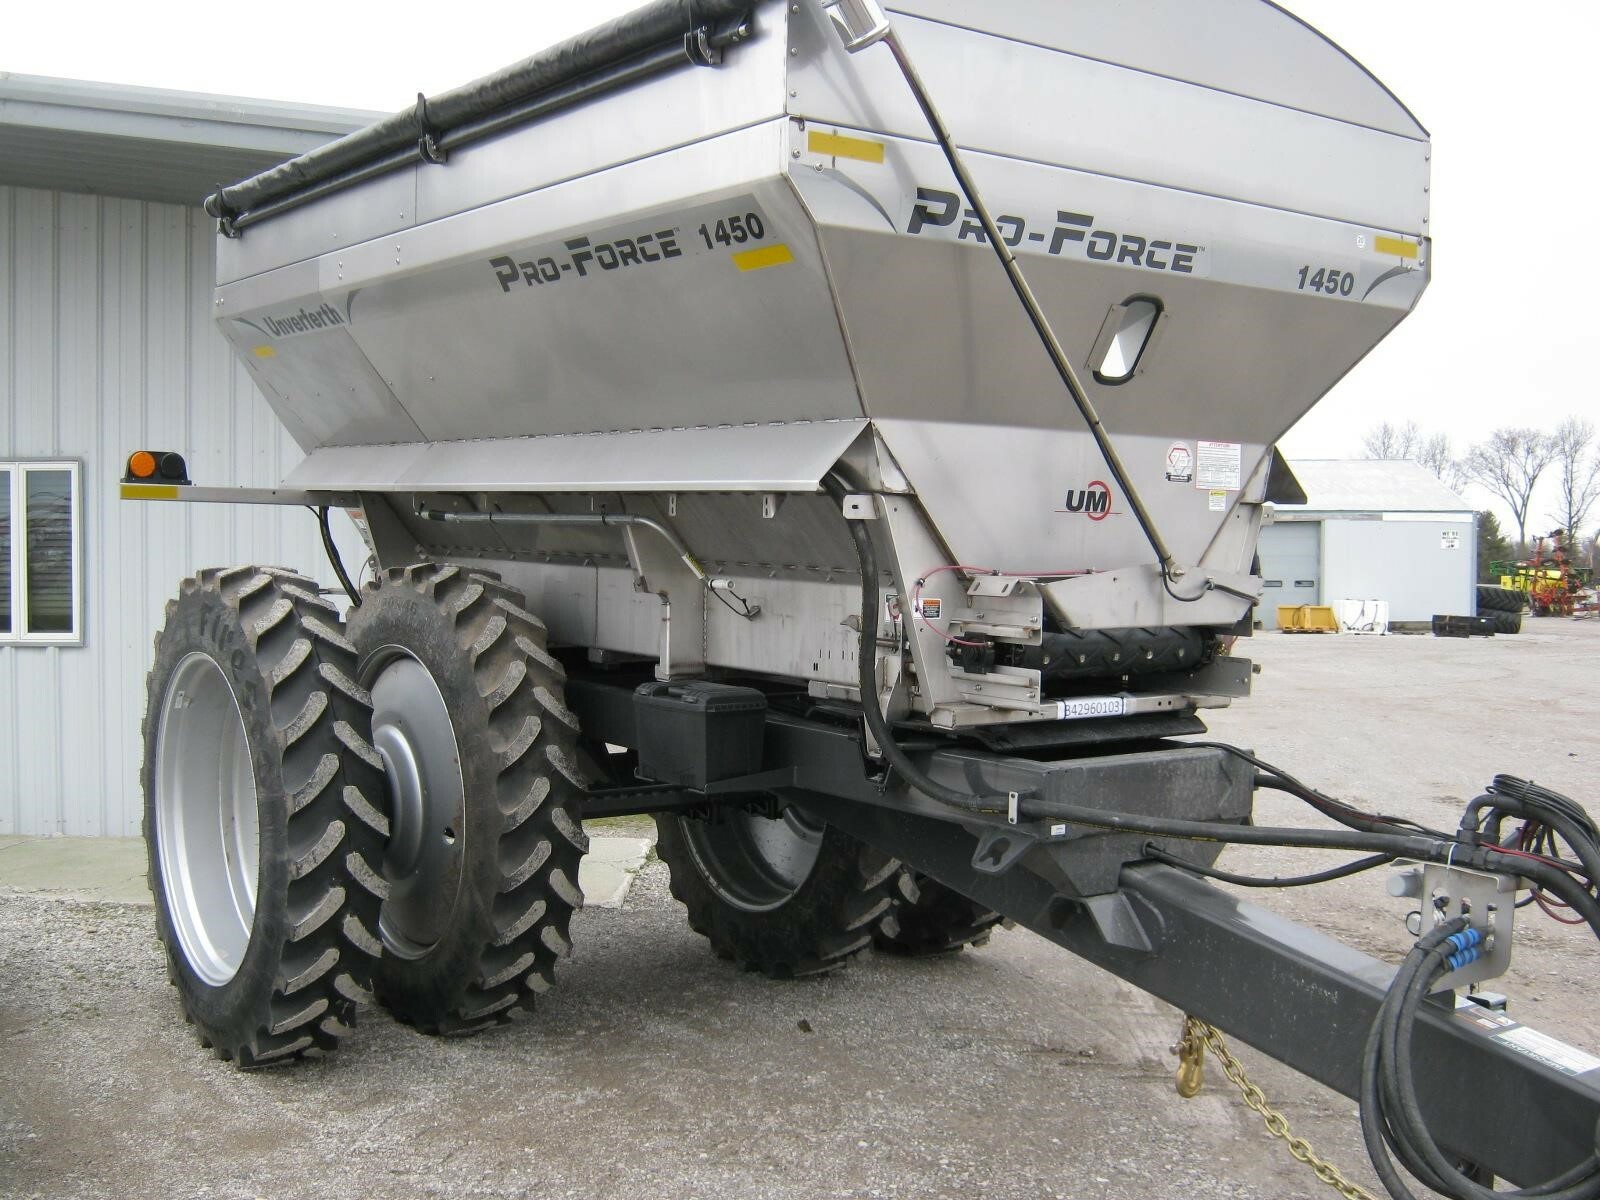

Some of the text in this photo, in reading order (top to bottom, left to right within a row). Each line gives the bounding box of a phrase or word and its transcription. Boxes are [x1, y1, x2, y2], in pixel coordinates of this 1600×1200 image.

[698, 212, 765, 250] 1450
[1298, 265, 1355, 297] 1450
[262, 303, 344, 337] Unverferth
[1065, 489, 1108, 512] UM
